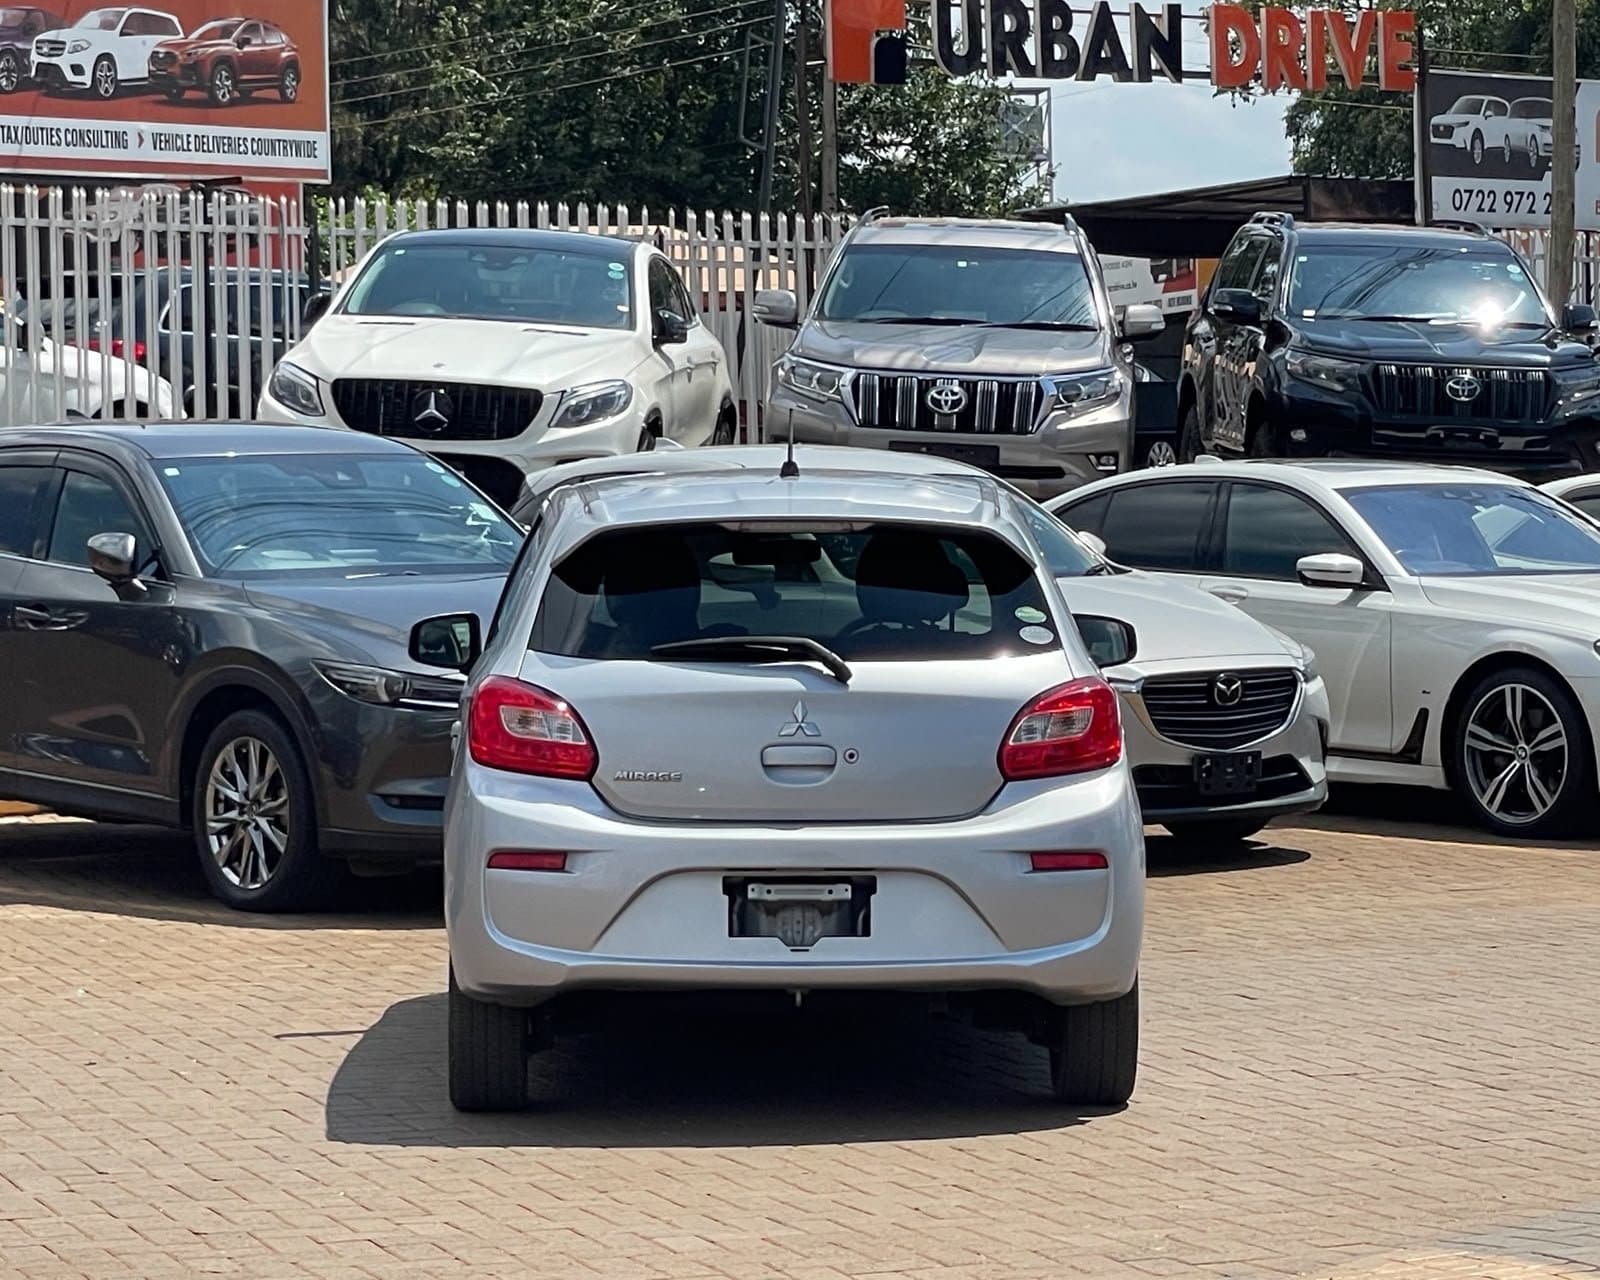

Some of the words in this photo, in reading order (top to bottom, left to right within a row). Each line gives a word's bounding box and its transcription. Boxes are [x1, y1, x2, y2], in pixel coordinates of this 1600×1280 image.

[931, 0, 1182, 83] URBAN
[1210, 4, 1416, 92] DRIVE
[0, 125, 62, 147] TAX/DUTIES
[64, 128, 129, 150] CONSULTING
[151, 132, 192, 152] VEHICLE
[194, 134, 248, 155] DELIVERIES
[250, 137, 318, 159] COUNTRYWIDE
[1452, 188, 1496, 213] 0722
[1503, 190, 1536, 214] 972
[1543, 192, 1553, 215] 2
[613, 770, 682, 783] MIRAGE
